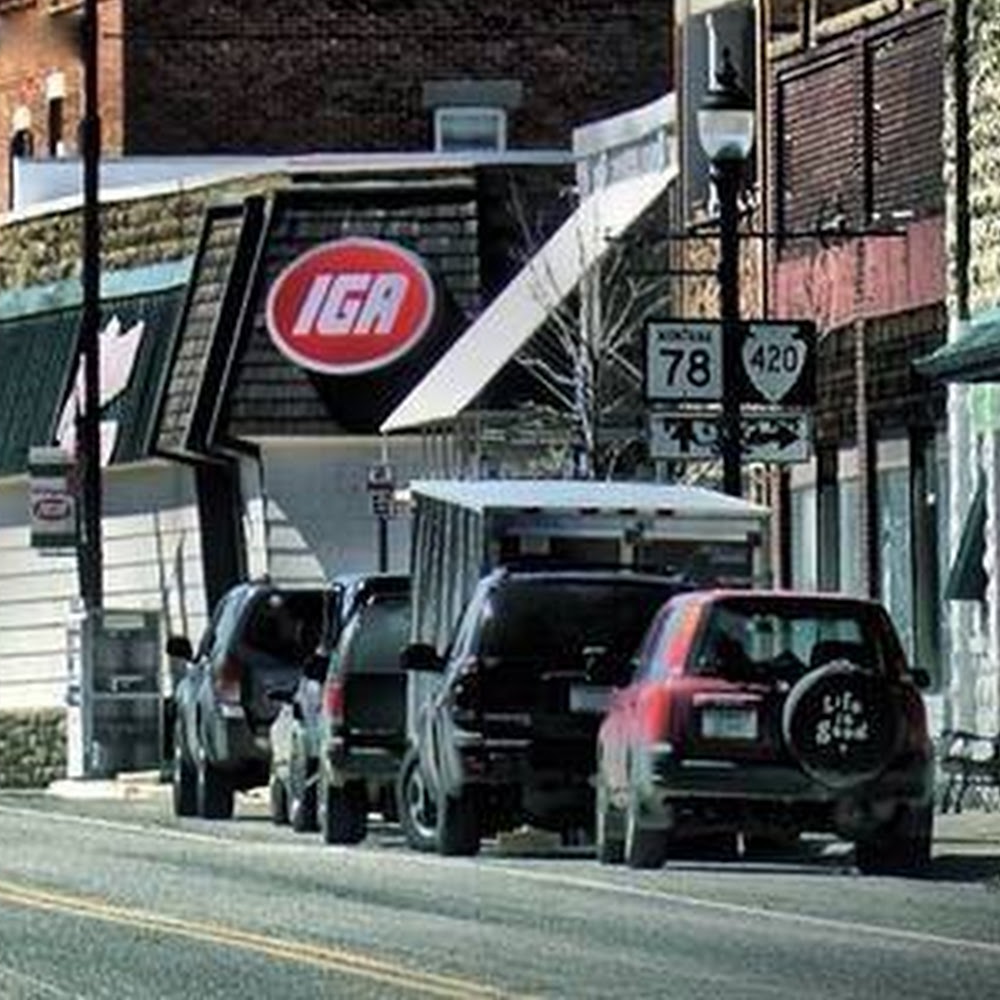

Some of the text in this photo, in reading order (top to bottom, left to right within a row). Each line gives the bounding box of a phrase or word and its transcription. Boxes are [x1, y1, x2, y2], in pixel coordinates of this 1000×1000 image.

[292, 273, 409, 336] IGA
[658, 348, 711, 388] 78
[750, 343, 799, 373] 420
